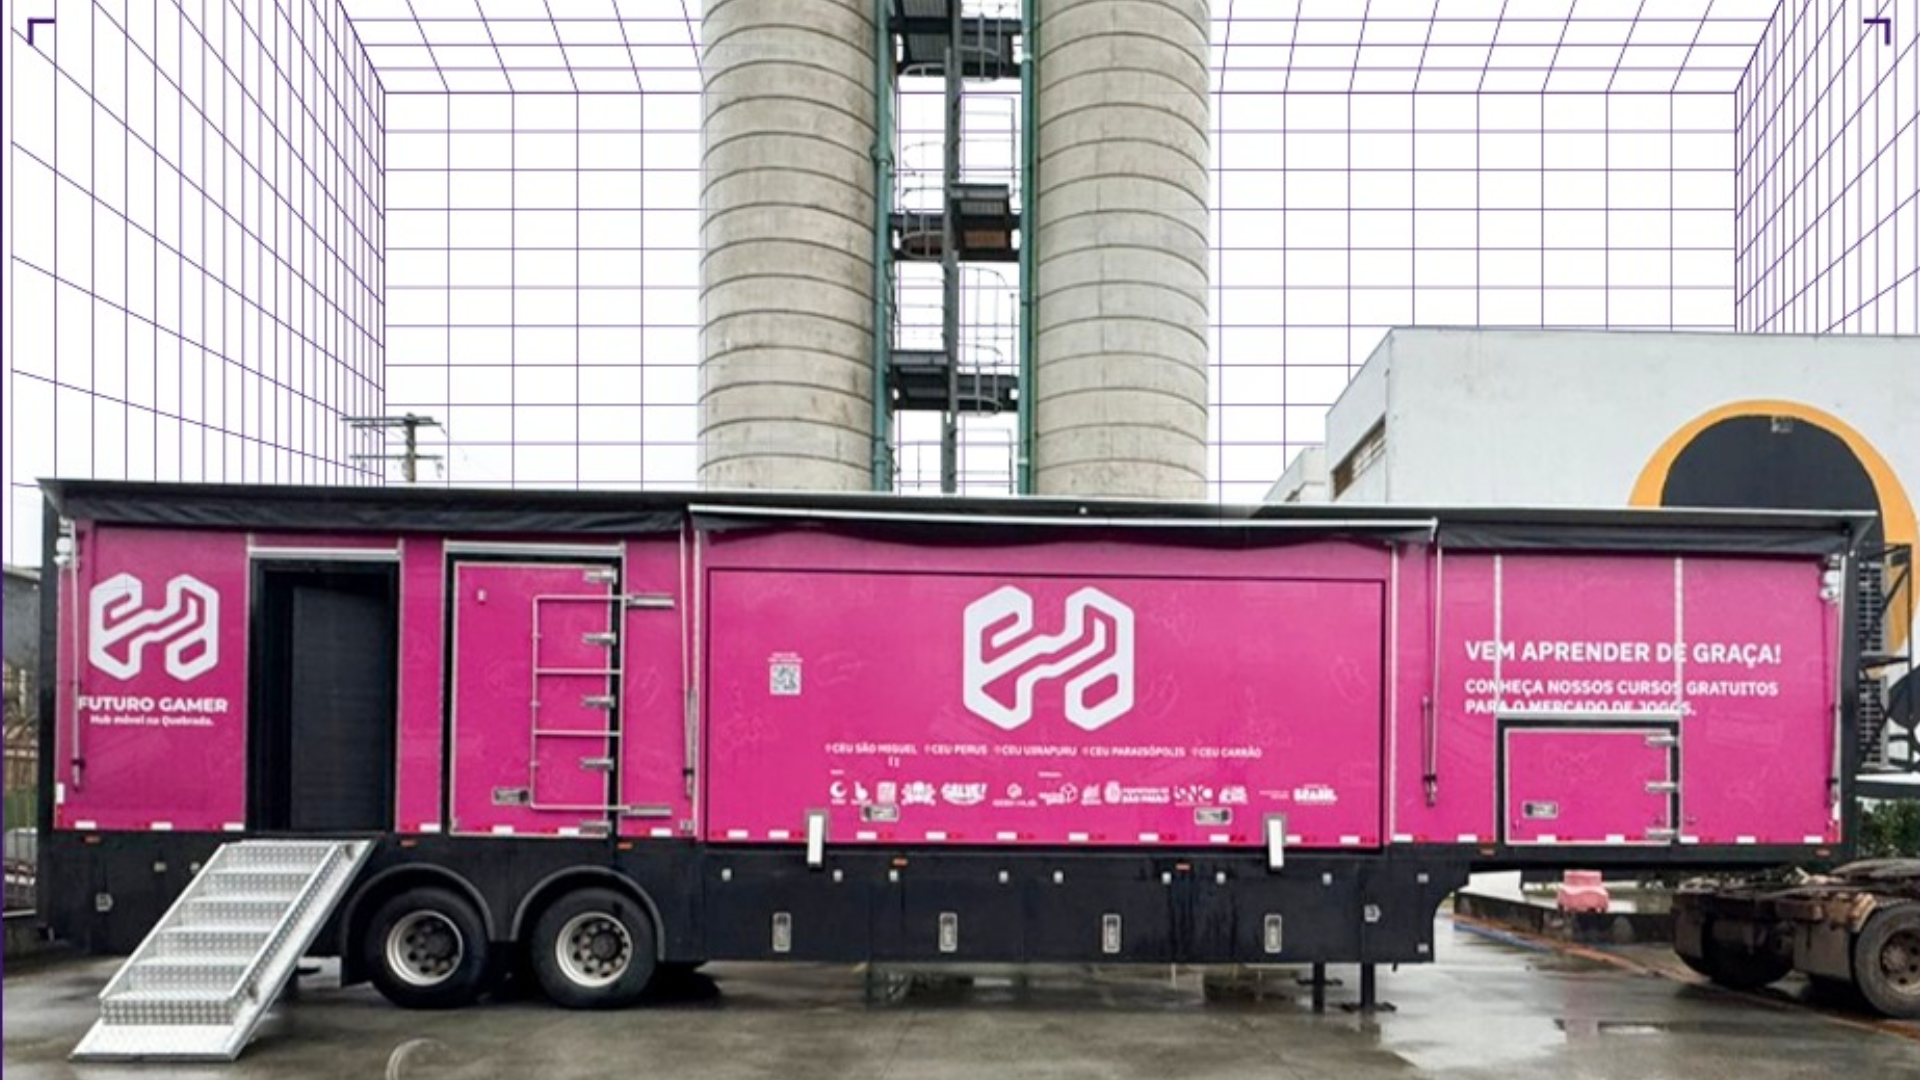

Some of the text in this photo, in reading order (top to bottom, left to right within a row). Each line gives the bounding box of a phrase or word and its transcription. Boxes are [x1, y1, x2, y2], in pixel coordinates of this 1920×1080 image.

[1465, 641, 1782, 668] VEM APRENDER DE GRAÇA!
[1465, 679, 1778, 697] CONHEÇA NOSSOS CURSOS GRATUITOS
[78, 696, 228, 712] FUTURO GAMER
[1465, 700, 1508, 714] PARA
[1528, 701, 1607, 713] MERCADO
[90, 714, 111, 725] Hub
[114, 714, 144, 725] móvel
[146, 716, 159, 725] na
